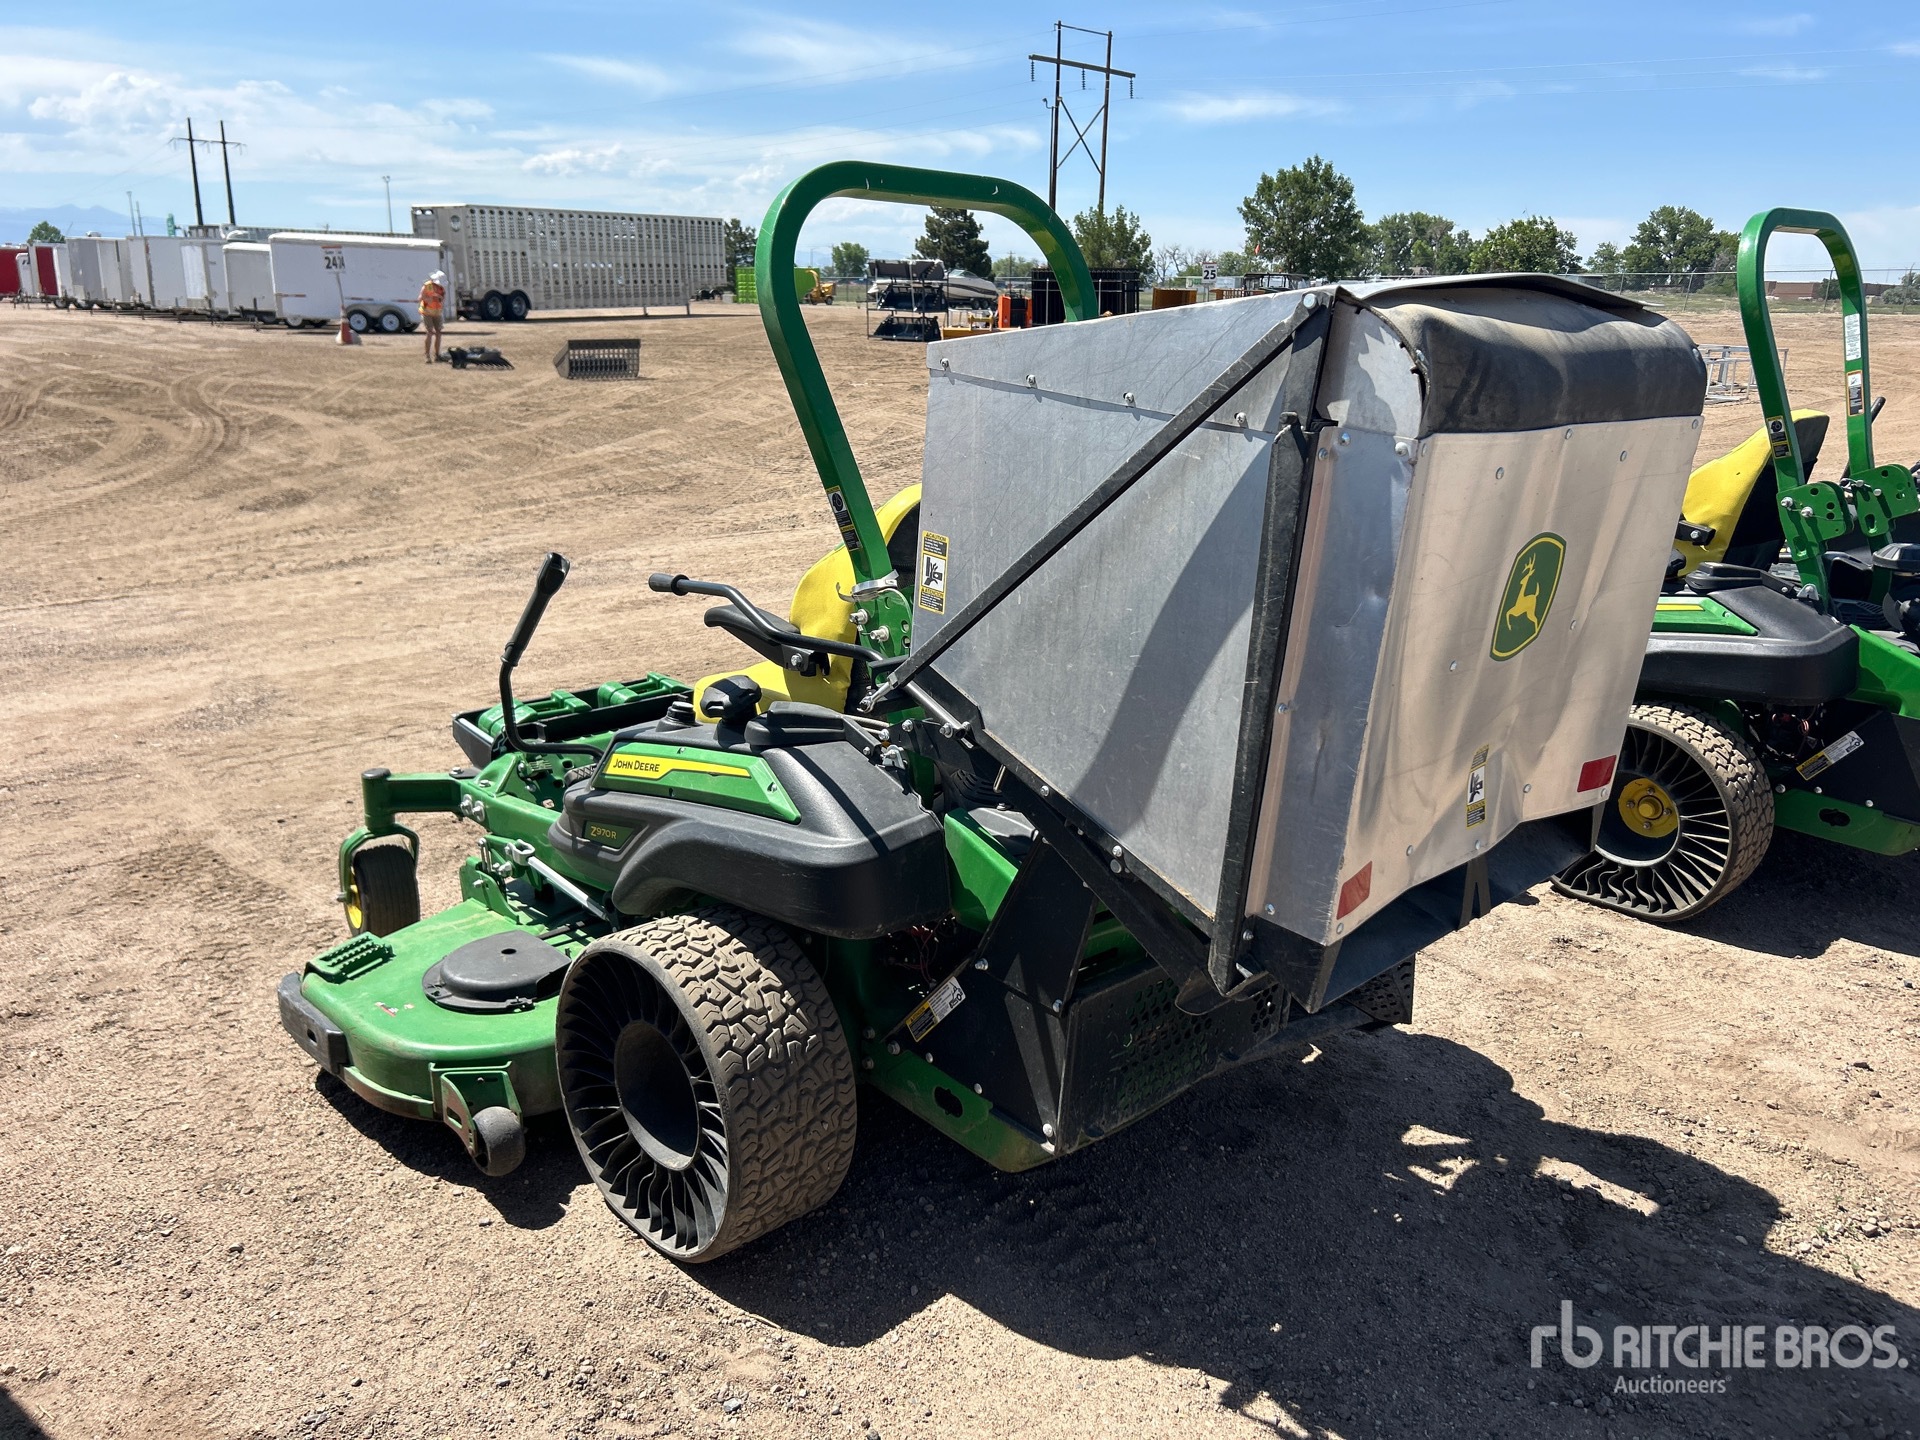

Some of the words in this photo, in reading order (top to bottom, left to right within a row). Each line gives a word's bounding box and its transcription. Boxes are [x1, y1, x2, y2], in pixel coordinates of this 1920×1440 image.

[1203, 270, 1216, 280] 25
[612, 758, 633, 770] JOHN
[633, 759, 660, 772] DEERE
